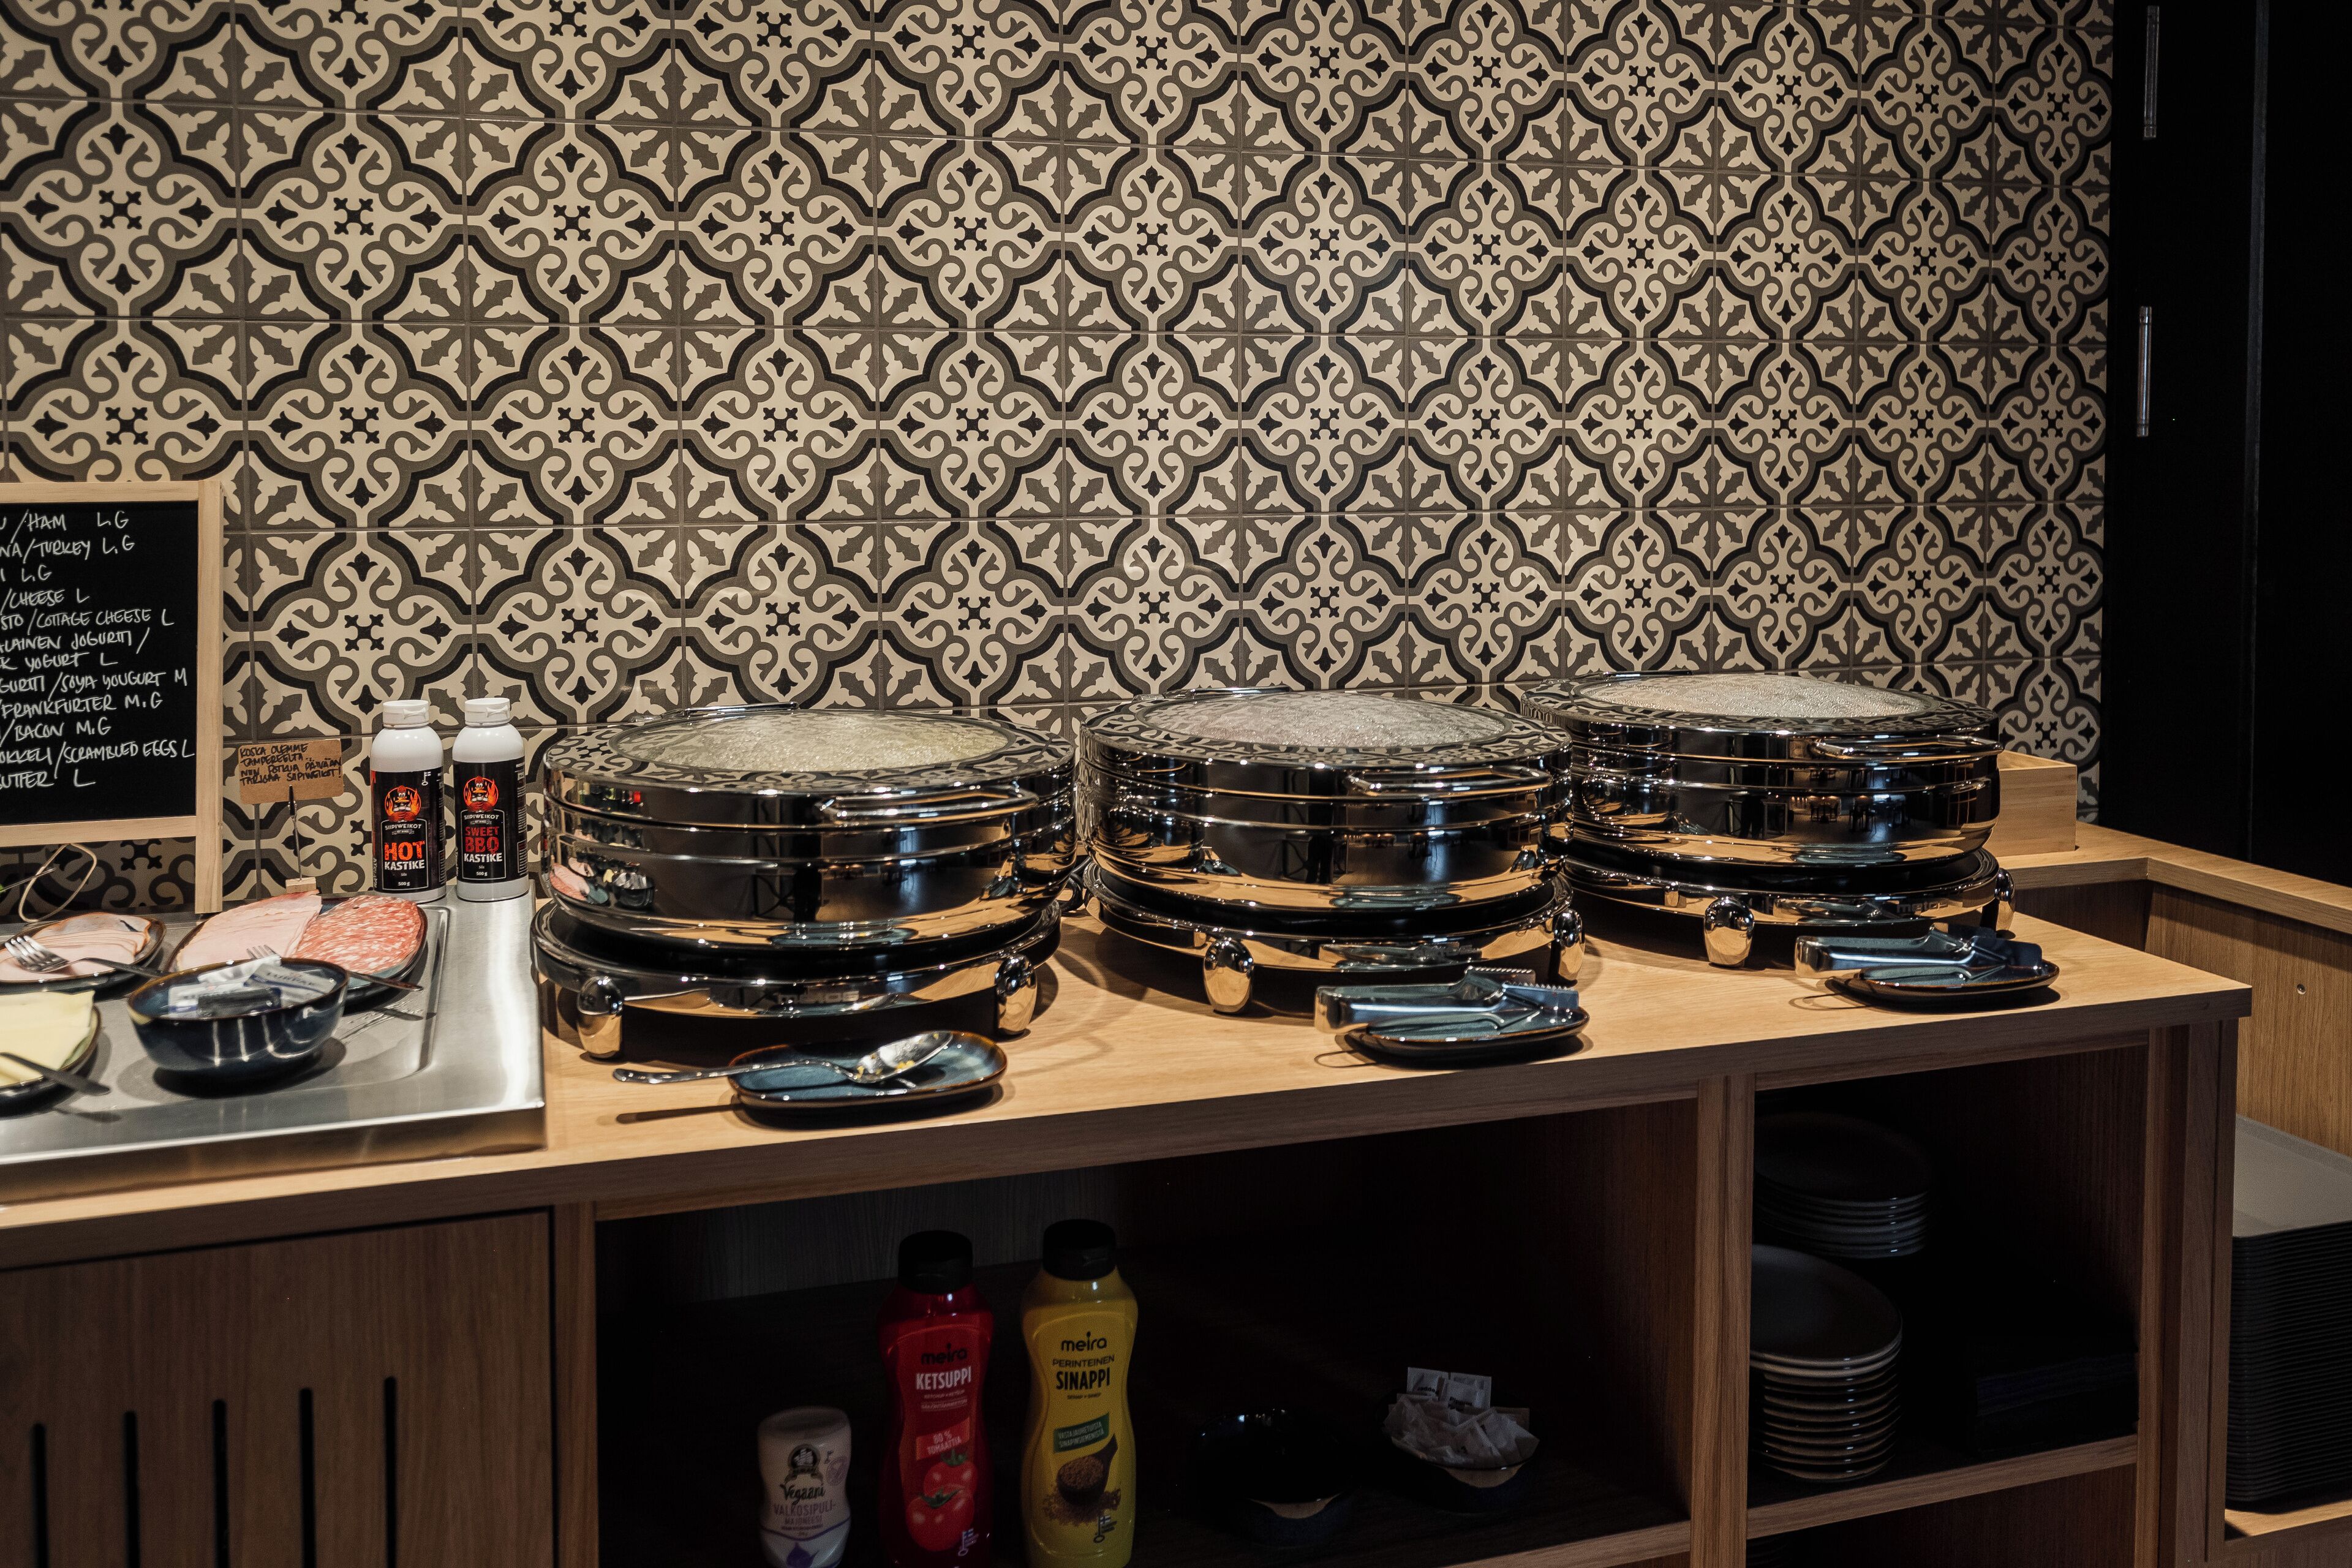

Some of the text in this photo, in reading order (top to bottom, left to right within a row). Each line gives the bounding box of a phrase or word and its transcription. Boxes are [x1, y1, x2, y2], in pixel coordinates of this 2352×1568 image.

[77, 588, 89, 603] L
[96, 609, 152, 625] CHEESE
[161, 609, 175, 626] L
[24, 652, 90, 673] YOGURT
[100, 652, 118, 666] L
[175, 668, 187, 686] M
[143, 739, 178, 758] EGGS
[182, 739, 195, 758] L
[240, 743, 309, 758] KOSKA OLEMME
[74, 769, 96, 787] L
[465, 826, 500, 837] SWEET
[384, 840, 425, 861] HOT
[465, 836, 499, 854] BBQ
[384, 859, 425, 871] KASTIKE
[464, 852, 503, 863] KASTIKE
[1061, 1331, 1107, 1352] meira
[921, 1343, 968, 1365] meira
[1052, 1353, 1115, 1368] PERINTEINEN
[916, 1365, 972, 1390] KETSUPPI
[1056, 1367, 1110, 1390] SINAPPI
[779, 1483, 826, 1506] Vegaani
